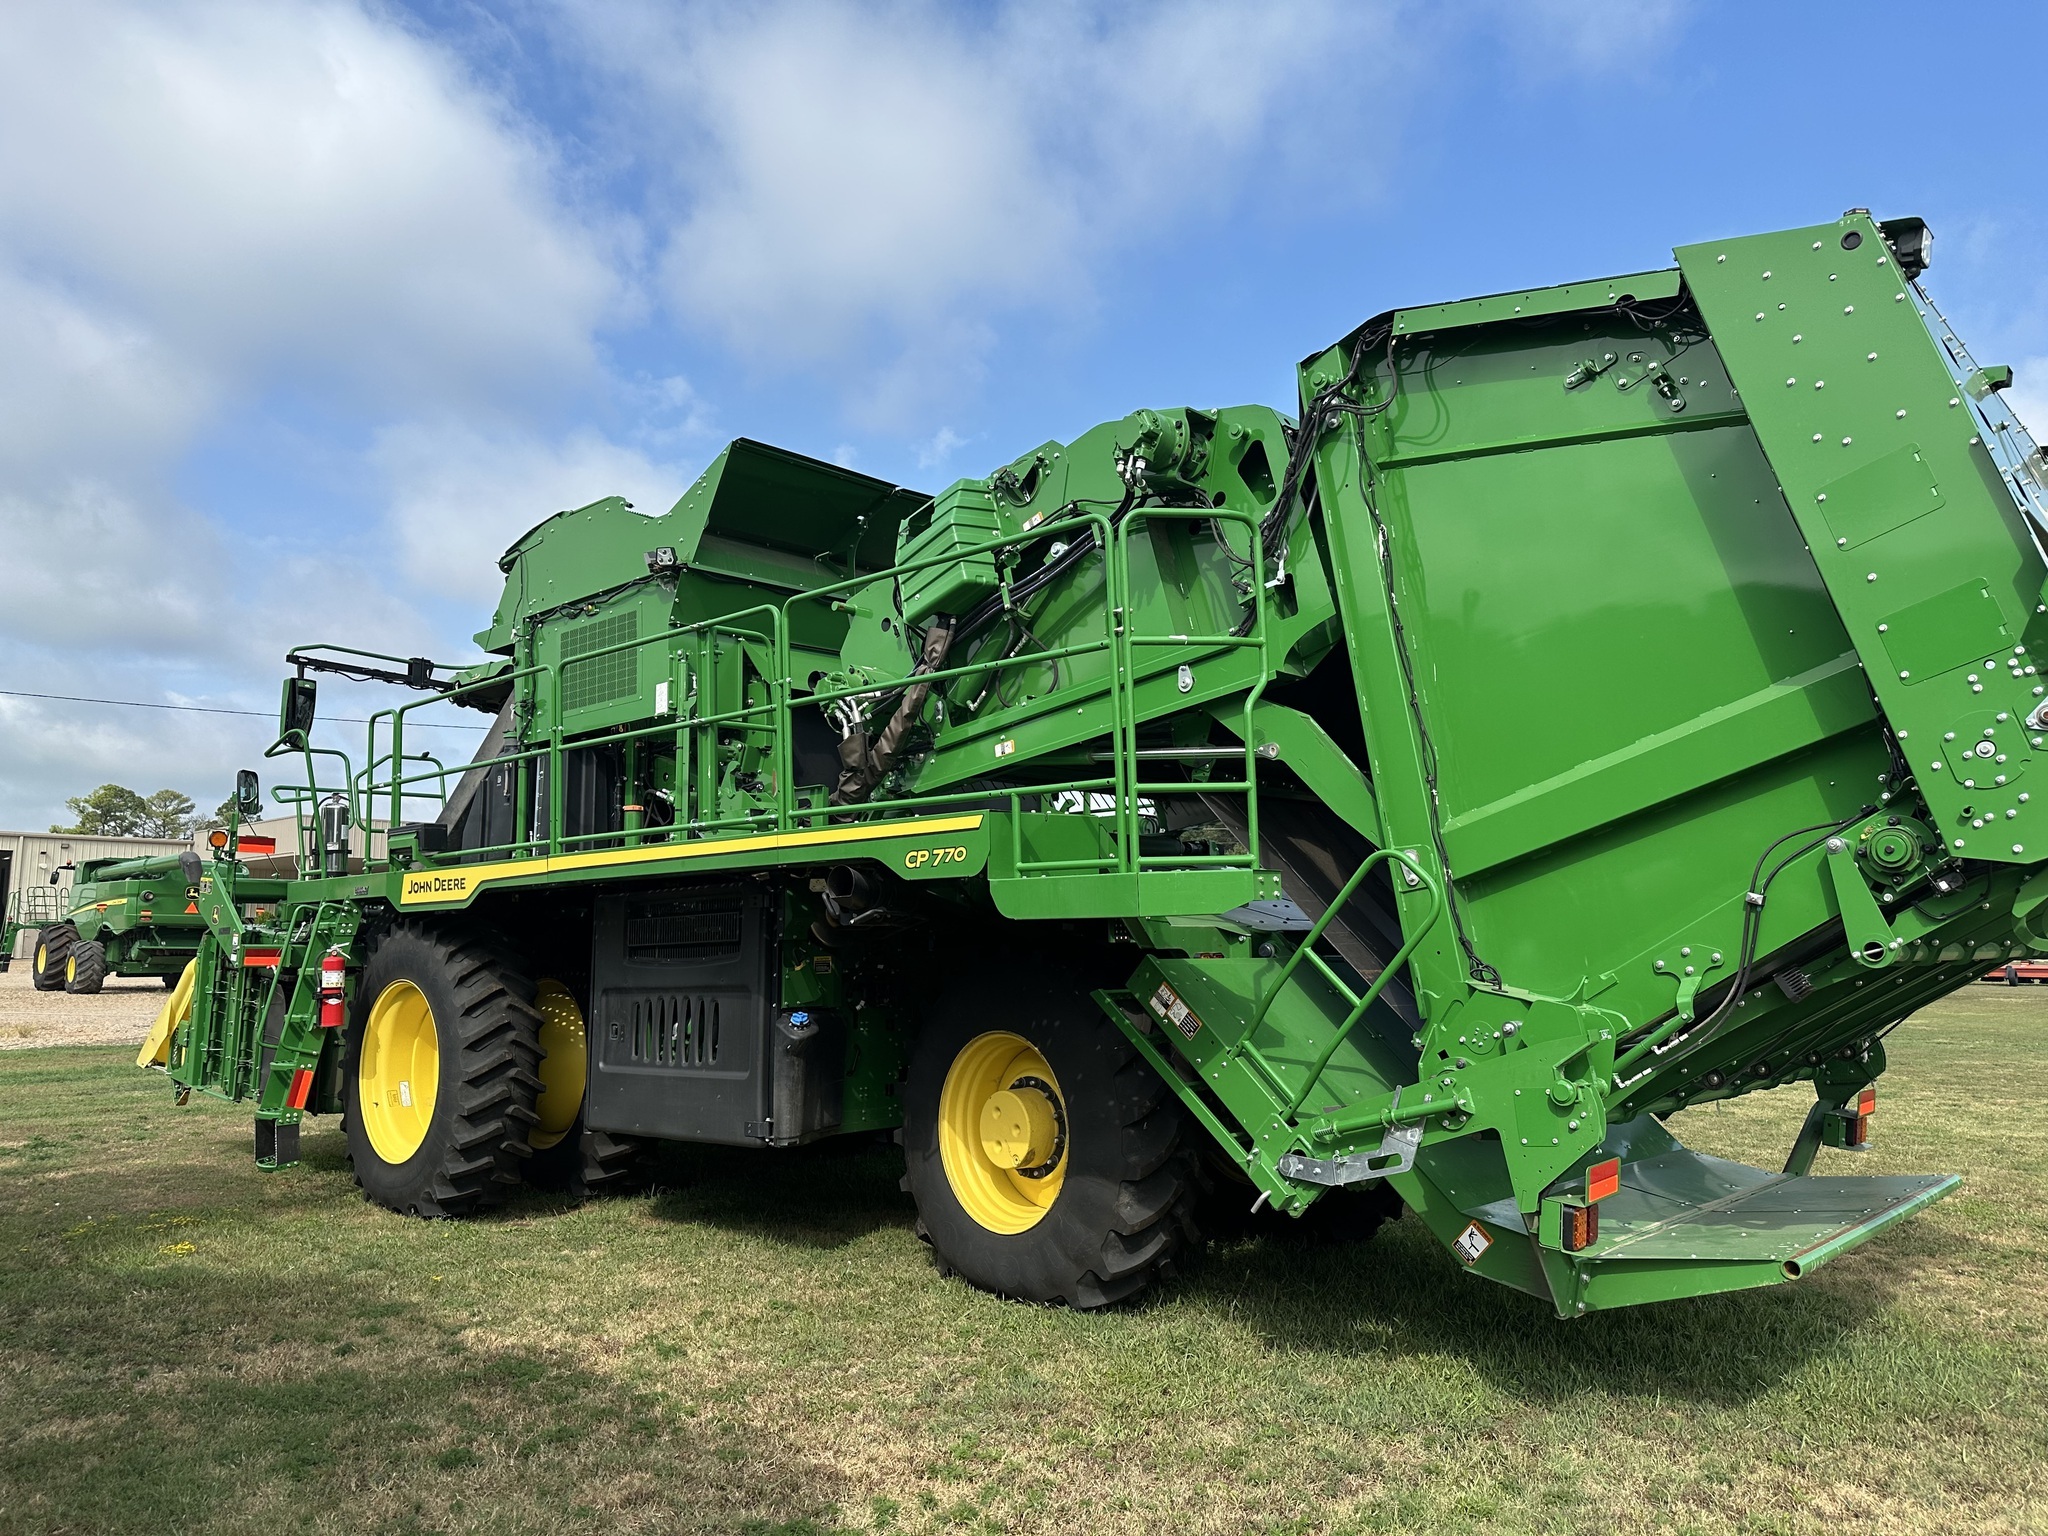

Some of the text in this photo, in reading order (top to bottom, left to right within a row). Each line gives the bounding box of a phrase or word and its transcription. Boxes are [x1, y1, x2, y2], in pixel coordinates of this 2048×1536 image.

[905, 846, 967, 869] CP 770
[408, 878, 466, 894] JOHN DEERE
